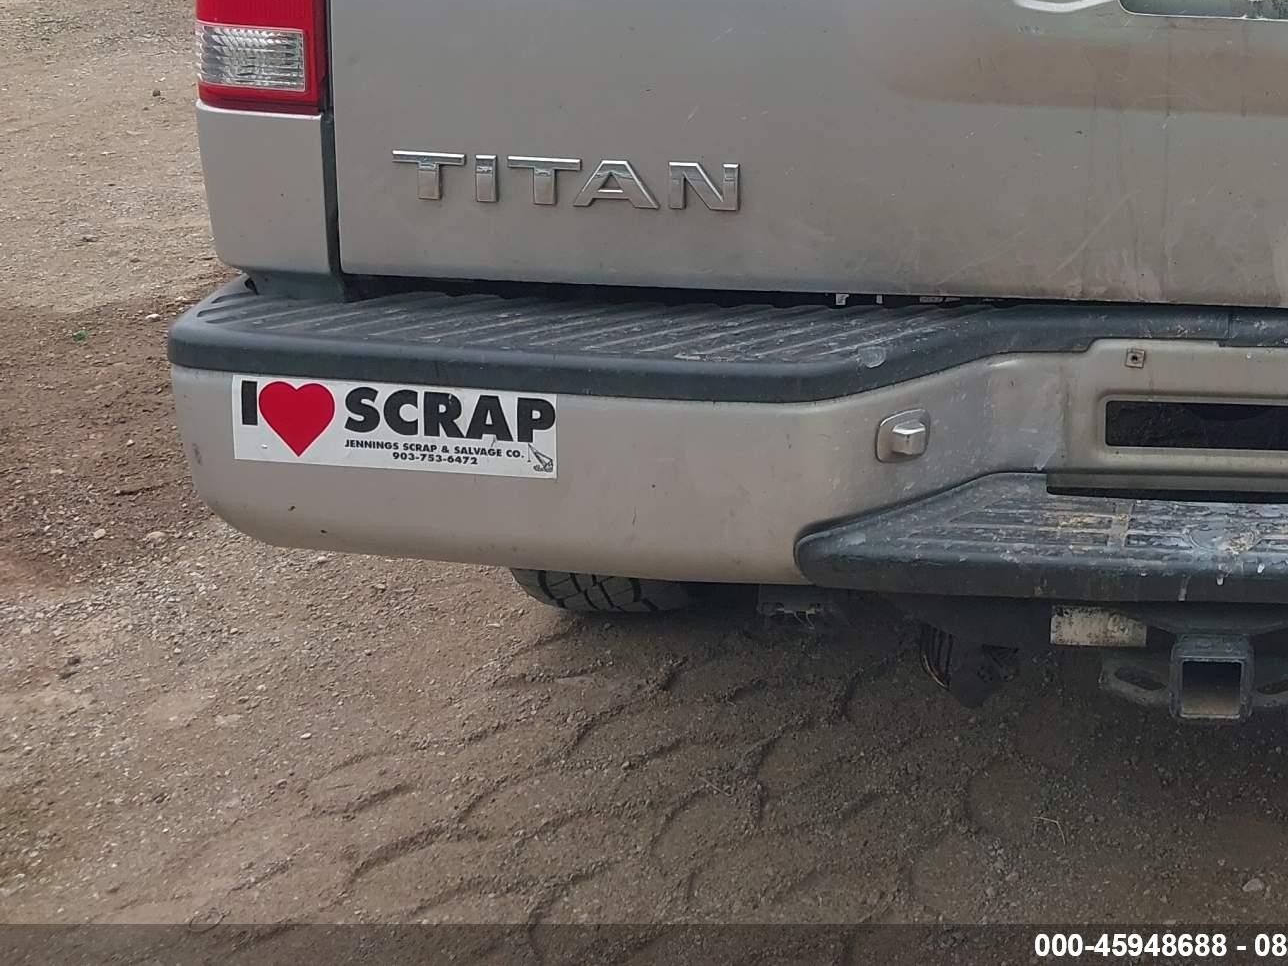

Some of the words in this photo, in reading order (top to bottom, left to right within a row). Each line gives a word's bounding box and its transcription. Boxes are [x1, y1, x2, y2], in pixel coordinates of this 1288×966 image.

[391, 149, 741, 211] TITAN
[241, 380, 259, 426] I
[344, 386, 556, 443] SCRAP
[344, 439, 400, 450] JENNINGS
[402, 442, 438, 453] SCRAP
[441, 445, 450, 453] &
[454, 446, 502, 457] SALVAGE
[506, 450, 525, 459] CO.
[392, 452, 478, 465] 903-753-6472
